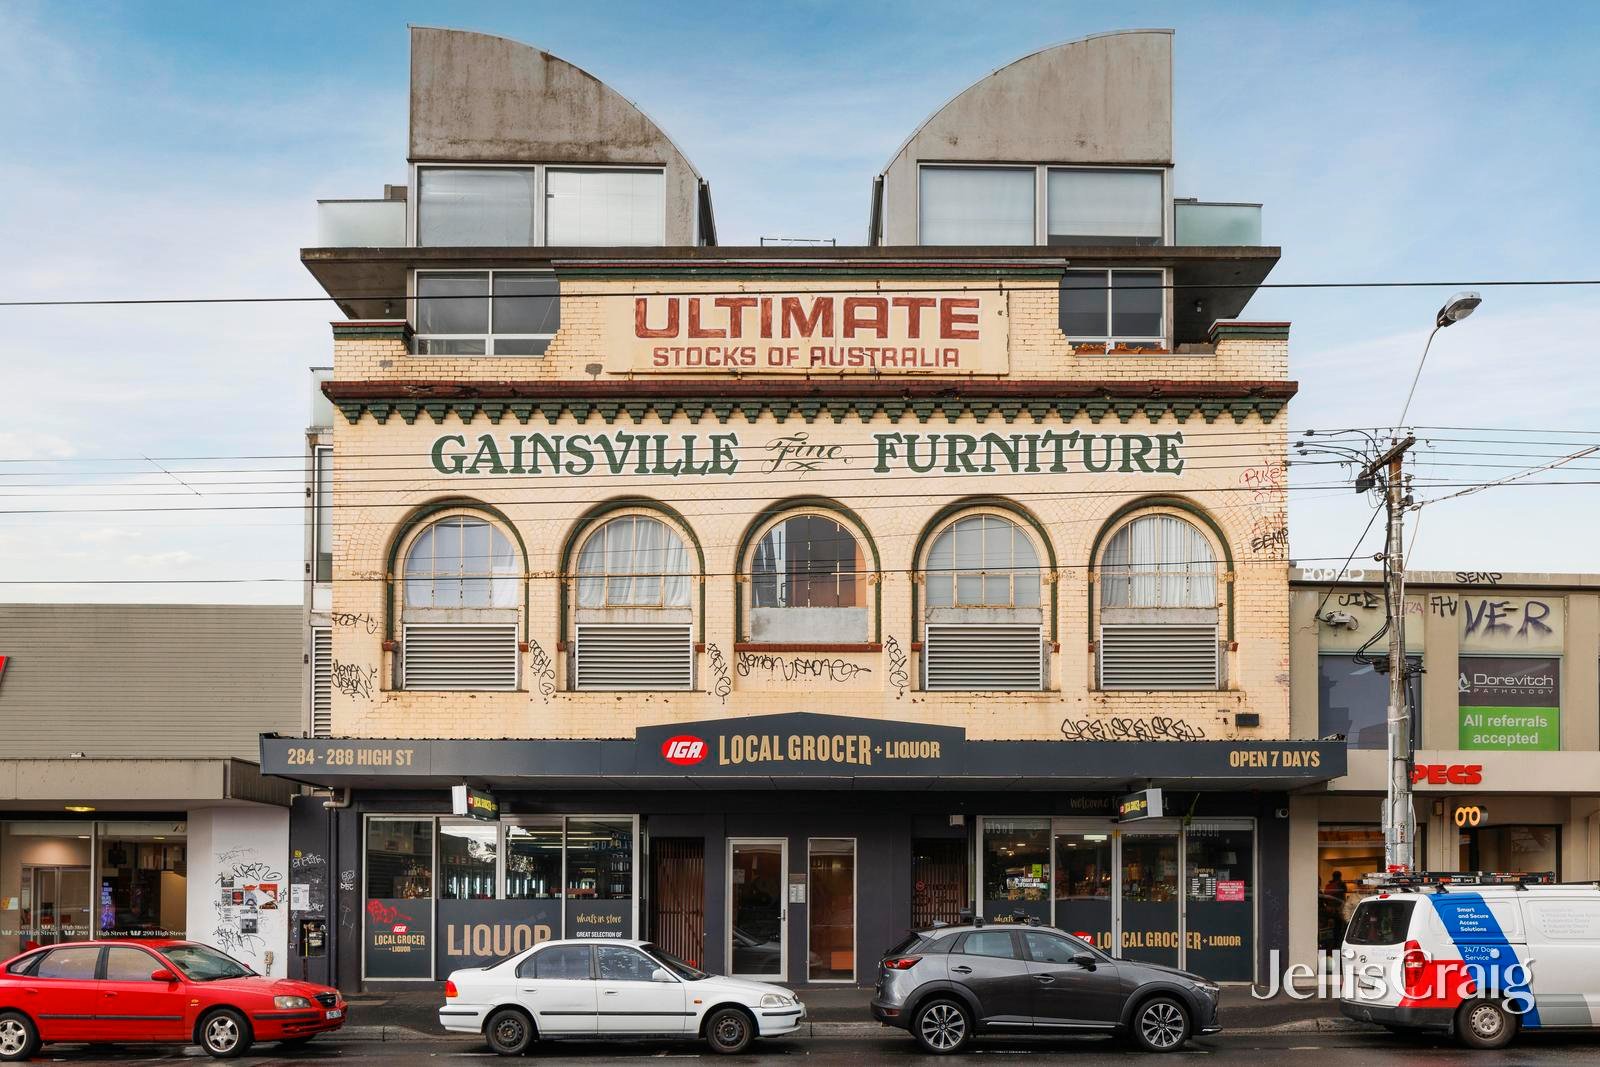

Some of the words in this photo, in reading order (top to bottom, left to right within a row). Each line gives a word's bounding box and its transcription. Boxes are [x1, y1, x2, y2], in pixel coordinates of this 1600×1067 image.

[635, 297, 980, 340] ULTIMATE
[653, 346, 757, 367] STOCKS
[768, 346, 800, 367] OF
[811, 346, 960, 368] AUSTRALIA
[431, 430, 739, 477] GAINSVILLE
[761, 431, 855, 480] Fine
[873, 429, 1184, 476] FURNITURE
[1456, 571, 1502, 584] SEMP
[1463, 599, 1553, 640] VER
[1473, 673, 1553, 686] Dorevitch
[1464, 714, 1483, 727] All
[1487, 714, 1549, 728] referrals
[1473, 733, 1539, 747] accepted
[287, 748, 315, 765] 284
[326, 748, 354, 765] 288
[357, 749, 392, 766] HIGH
[395, 749, 415, 766] ST
[665, 741, 702, 758] IGA
[719, 735, 784, 765] LOCAL
[788, 735, 872, 766] GROCER
[885, 741, 940, 759] LIQUOR
[1229, 750, 1268, 768] OPEN
[1270, 750, 1280, 767] 7
[1282, 750, 1320, 768] DAYS
[374, 934, 396, 946] LOCAL
[397, 934, 426, 946] GROCER
[392, 945, 411, 953] LIQUOR
[1097, 931, 1144, 949] LOCAL
[1145, 931, 1201, 950] GROCER
[1209, 935, 1241, 946] LIQUOR
